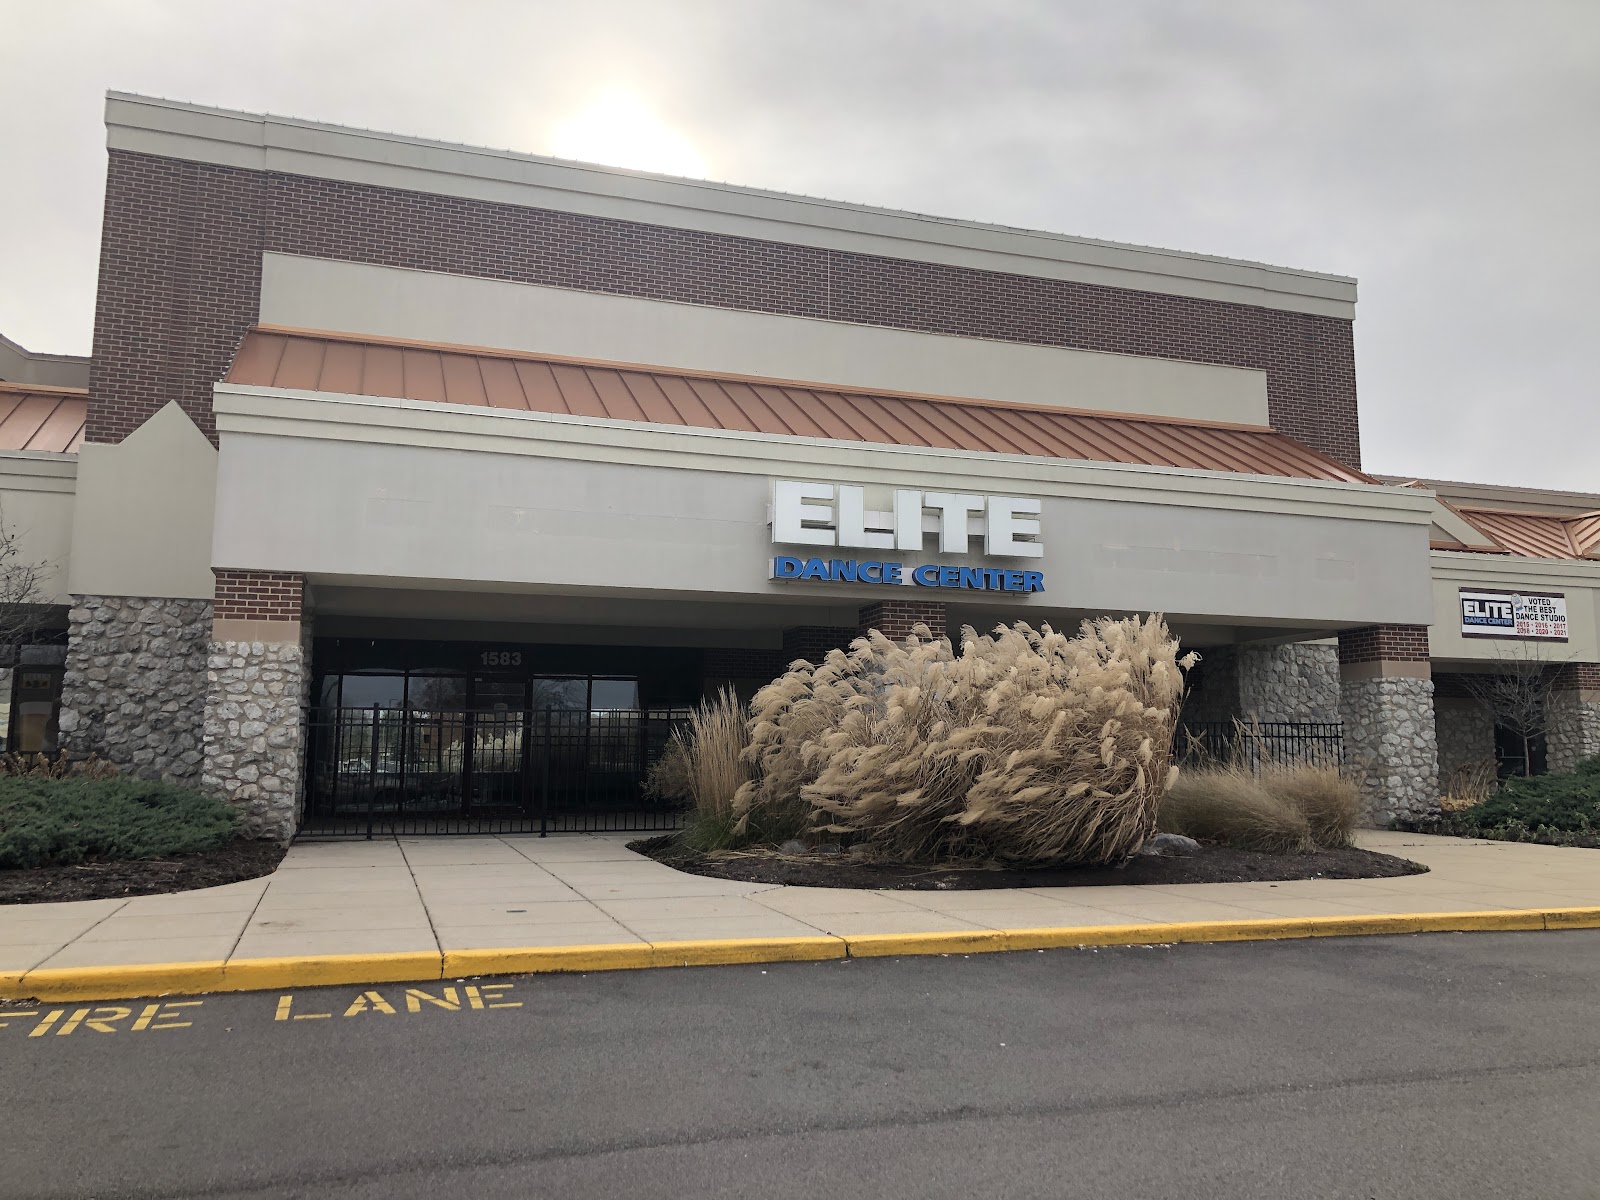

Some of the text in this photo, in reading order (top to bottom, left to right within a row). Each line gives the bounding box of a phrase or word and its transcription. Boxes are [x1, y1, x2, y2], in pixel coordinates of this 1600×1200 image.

[772, 480, 1044, 558] ELITE
[774, 556, 1045, 592] DANCE CENTER
[1524, 605, 1556, 614] THE BEST
[1528, 598, 1551, 606] VOTED
[1463, 601, 1513, 619] ELITE
[1516, 612, 1566, 622] DANCE STUDIO
[1488, 618, 1513, 626] CENTER
[480, 651, 522, 666] 1583
[274, 984, 525, 1021] LANE
